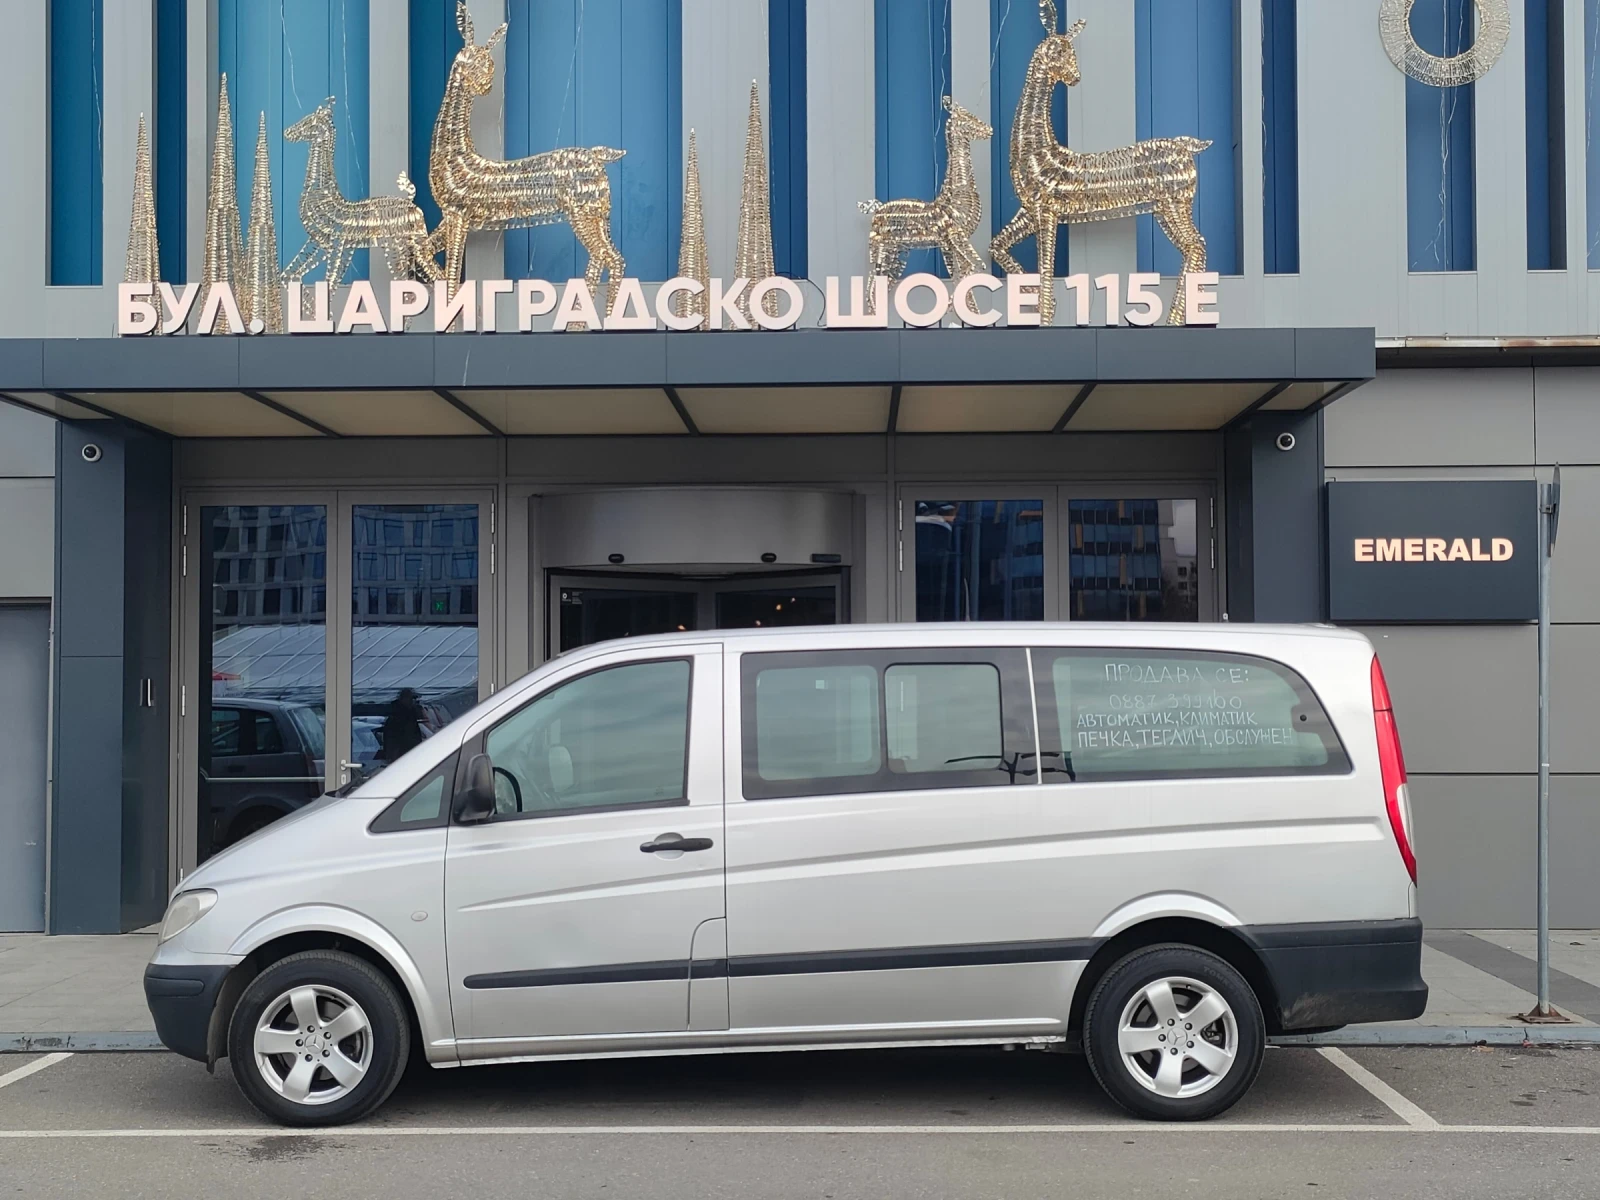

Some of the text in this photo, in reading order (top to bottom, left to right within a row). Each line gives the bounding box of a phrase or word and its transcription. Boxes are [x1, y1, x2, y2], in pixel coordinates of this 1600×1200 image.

[118, 281, 264, 336] БУЛ.
[288, 275, 803, 335] ЦАРИГРАДСКО
[825, 272, 1042, 330] ШОСЕ
[1065, 272, 1163, 328] 115
[1354, 538, 1514, 562] EMERALD
[1104, 663, 1207, 684] ПРОДАВА
